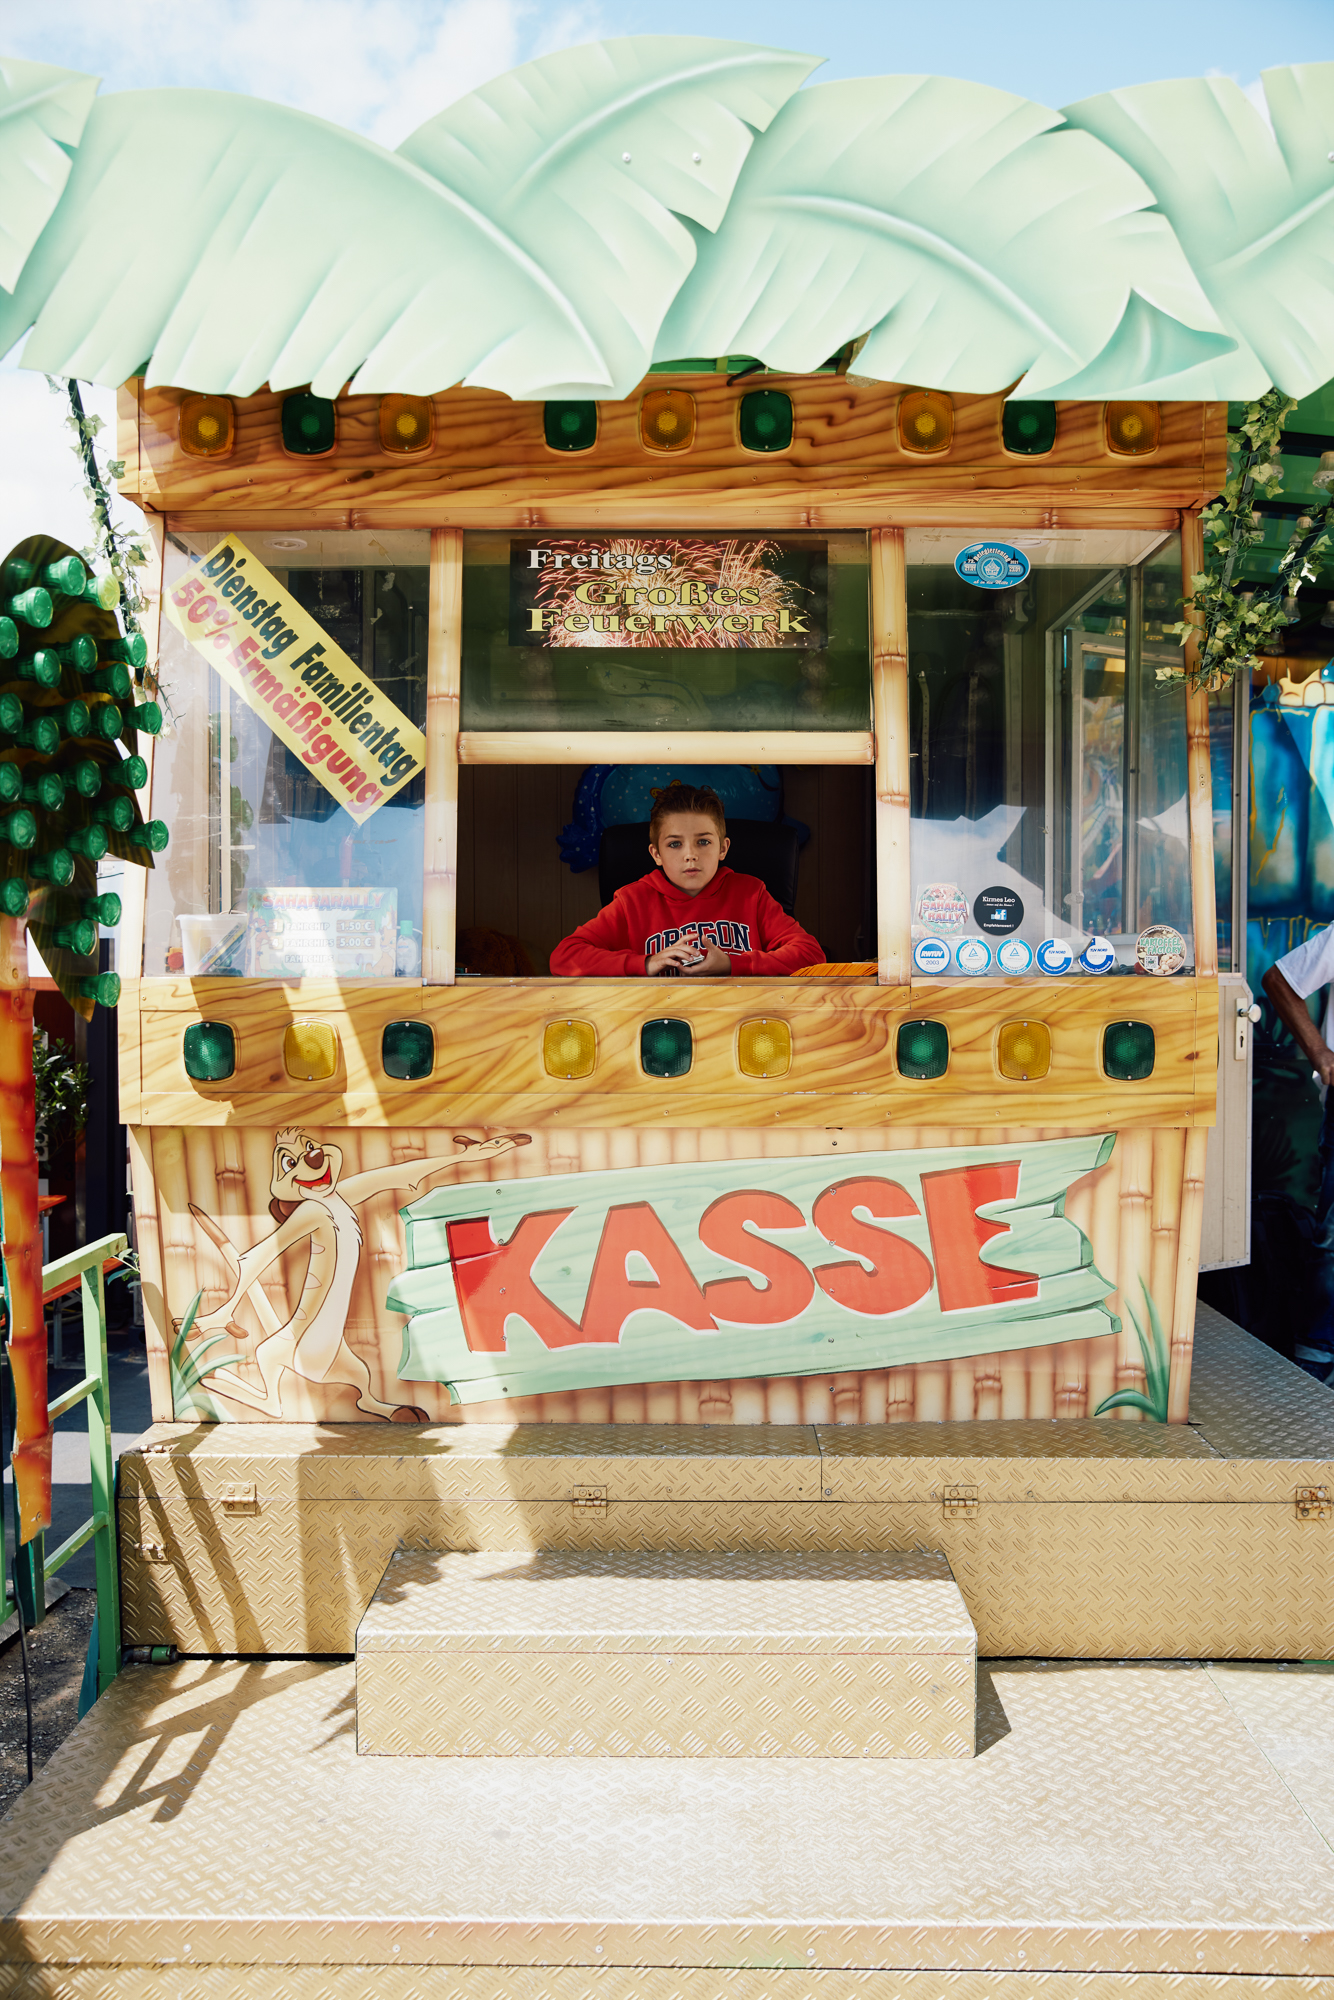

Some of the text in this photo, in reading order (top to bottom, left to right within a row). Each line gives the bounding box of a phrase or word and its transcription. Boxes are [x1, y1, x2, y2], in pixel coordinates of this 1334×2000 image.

[526, 548, 673, 575] Freitags
[574, 580, 761, 606] Großes
[526, 608, 811, 633] Feuerwerk
[200, 544, 419, 787] Dienstag Familientag
[170, 578, 384, 814] 50% Ermäßigung
[262, 892, 385, 911] SAHARARALLY
[922, 900, 966, 912] SAHARA
[927, 911, 962, 923] RALLY
[285, 922, 331, 931] FAHRCHIP
[340, 921, 361, 931] 1.50
[285, 939, 335, 948] FAHRCHIPS
[339, 938, 361, 947] 5.00
[1140, 937, 1181, 947] KARTOFFEL
[1147, 946, 1182, 954] FACTORY
[285, 955, 335, 963] FAHRCHIPS
[445, 1160, 1041, 1354] KASSE
